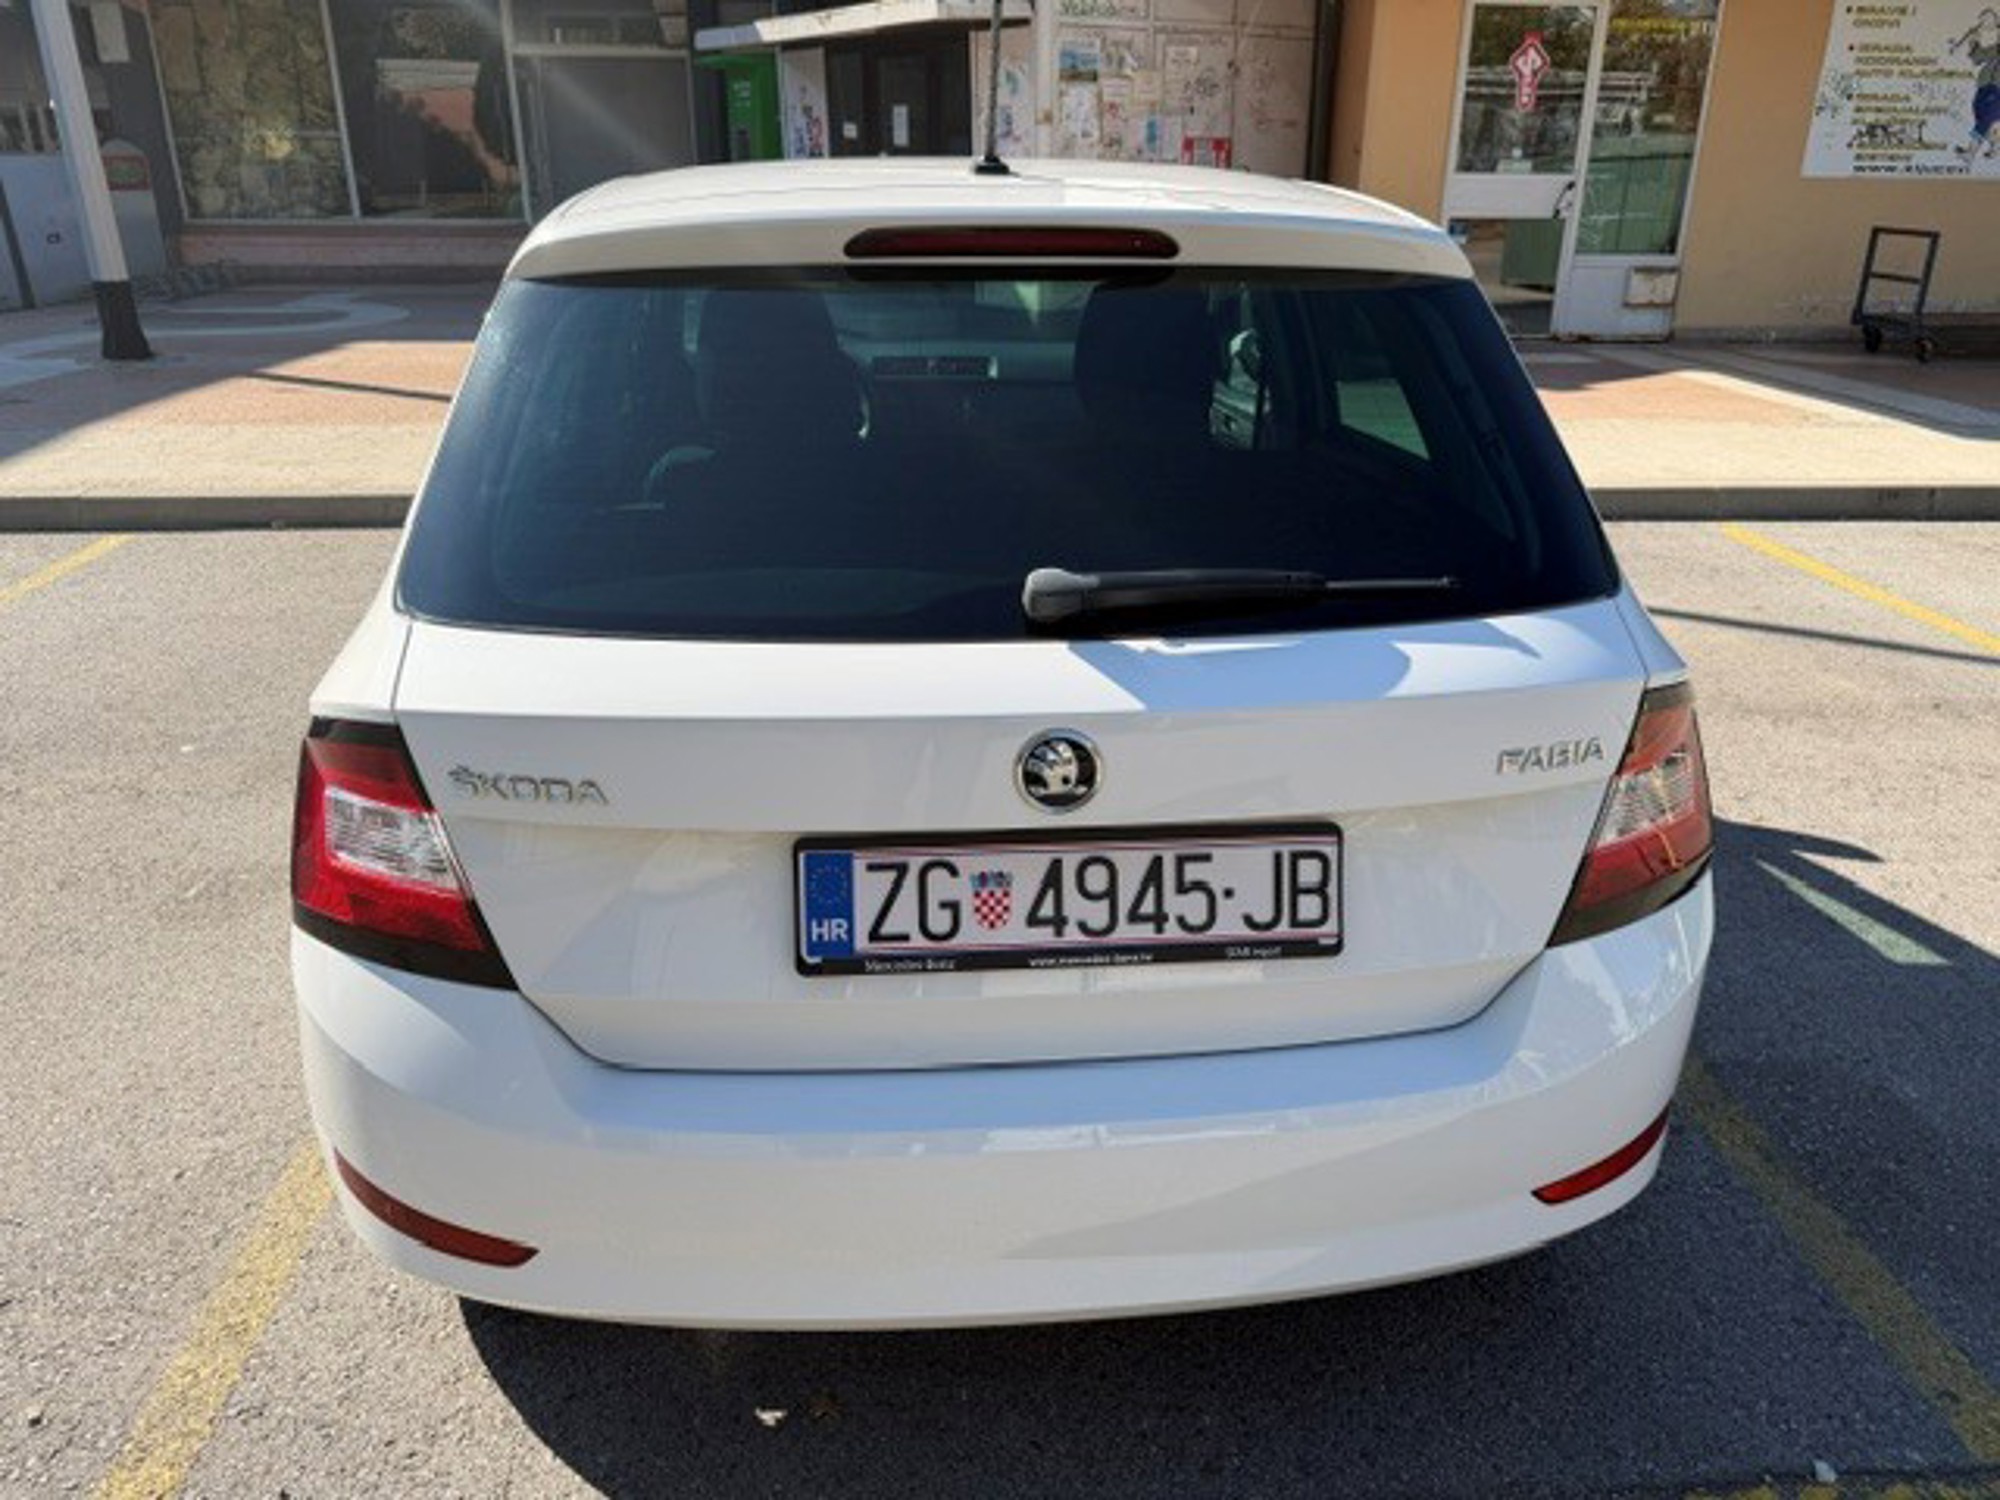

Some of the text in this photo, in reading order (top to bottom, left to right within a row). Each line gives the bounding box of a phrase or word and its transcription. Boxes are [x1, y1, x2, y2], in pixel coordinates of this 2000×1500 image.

[1497, 737, 1603, 774] FABIA
[448, 764, 608, 804] ŠKODA
[866, 859, 960, 943] ZG
[812, 918, 848, 942] HR
